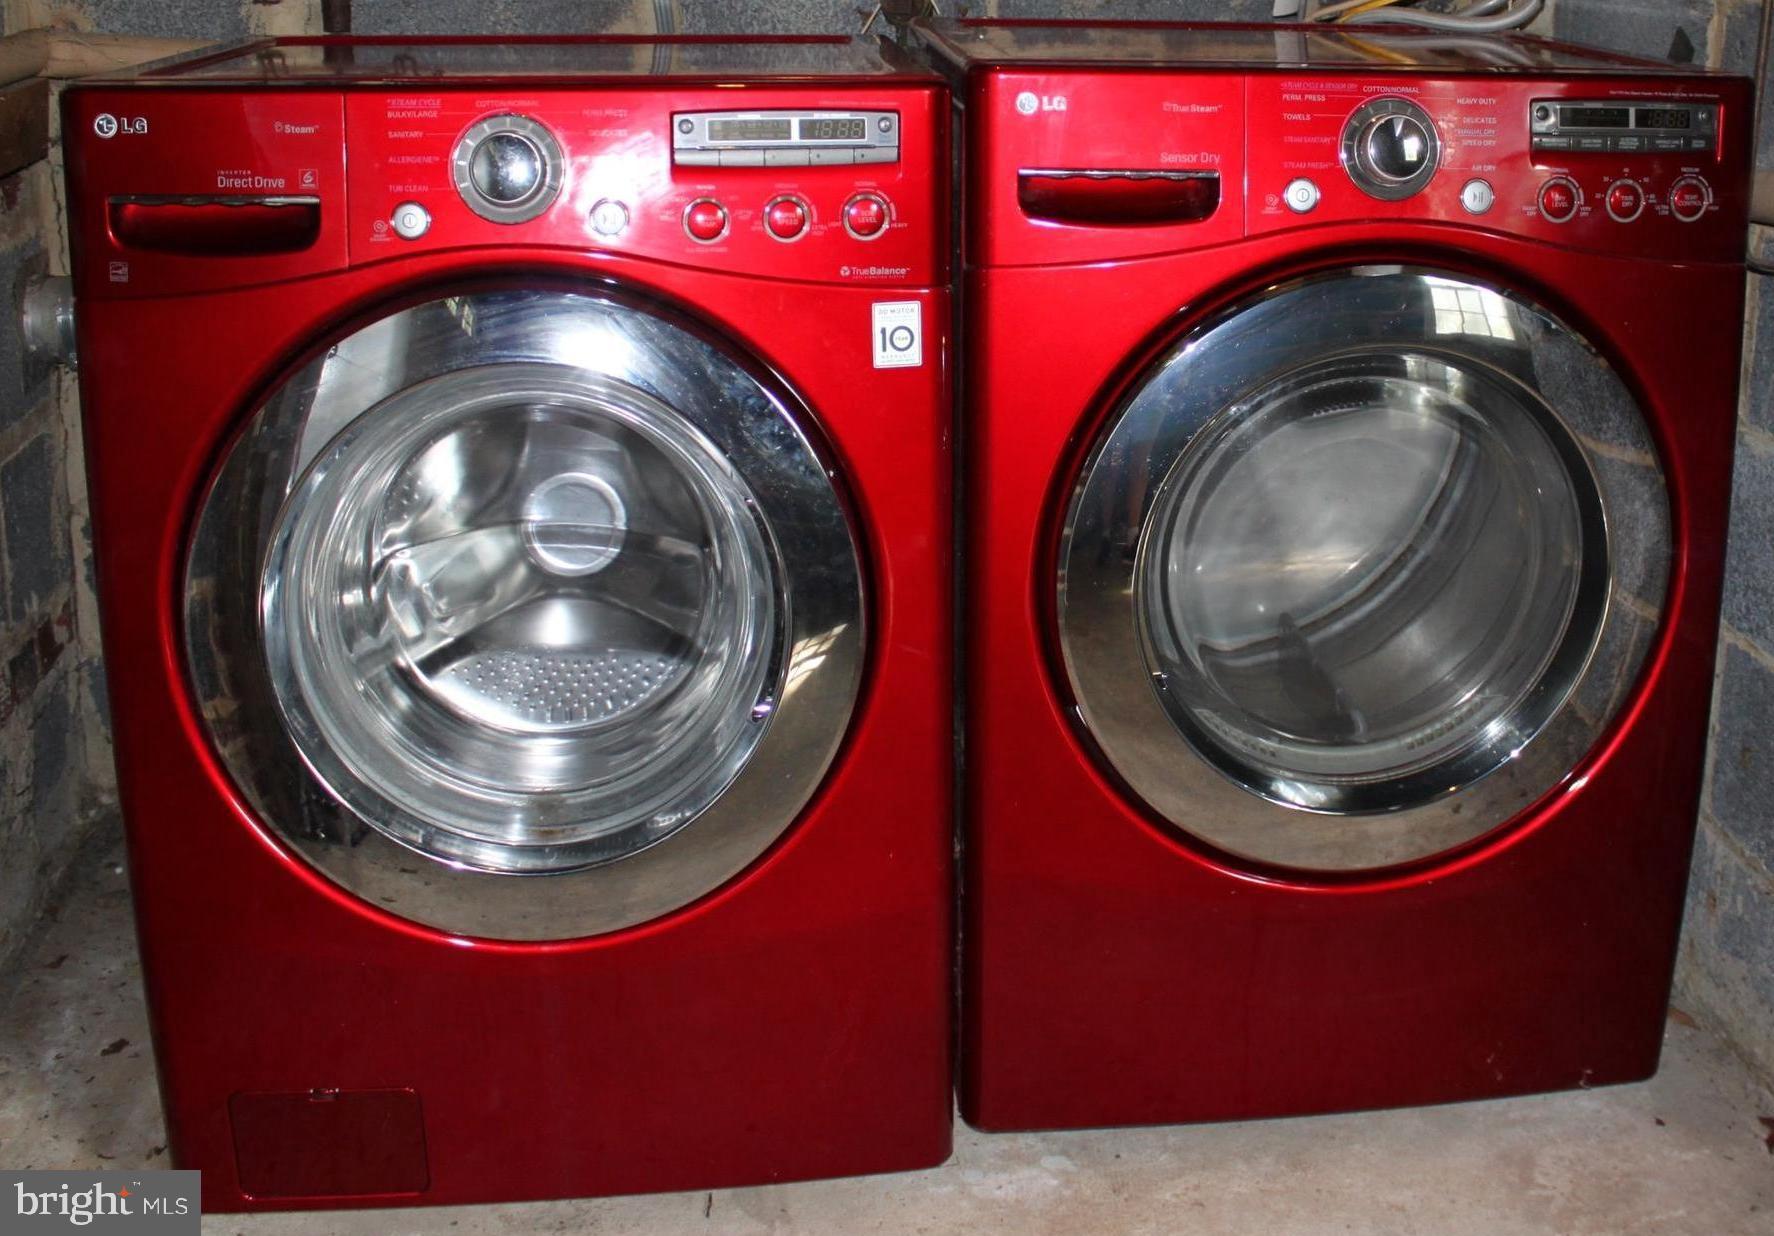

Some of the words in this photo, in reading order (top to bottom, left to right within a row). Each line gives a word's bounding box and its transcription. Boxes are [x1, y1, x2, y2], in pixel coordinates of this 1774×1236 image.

[1041, 95, 1068, 112] LG
[1304, 94, 1326, 102] PRESS
[1456, 96, 1478, 105] HEAVY
[1479, 96, 1497, 105] DUTY
[386, 110, 439, 119] BULKY/LARGE
[1283, 113, 1311, 121] TOWELS
[120, 117, 148, 134] LG
[1160, 152, 1198, 164] Sensor
[1200, 152, 1221, 165] Dry
[217, 176, 252, 189] Direct
[254, 176, 286, 189] Drive
[404, 185, 429, 193] CLEAN
[880, 325, 915, 353] 10
